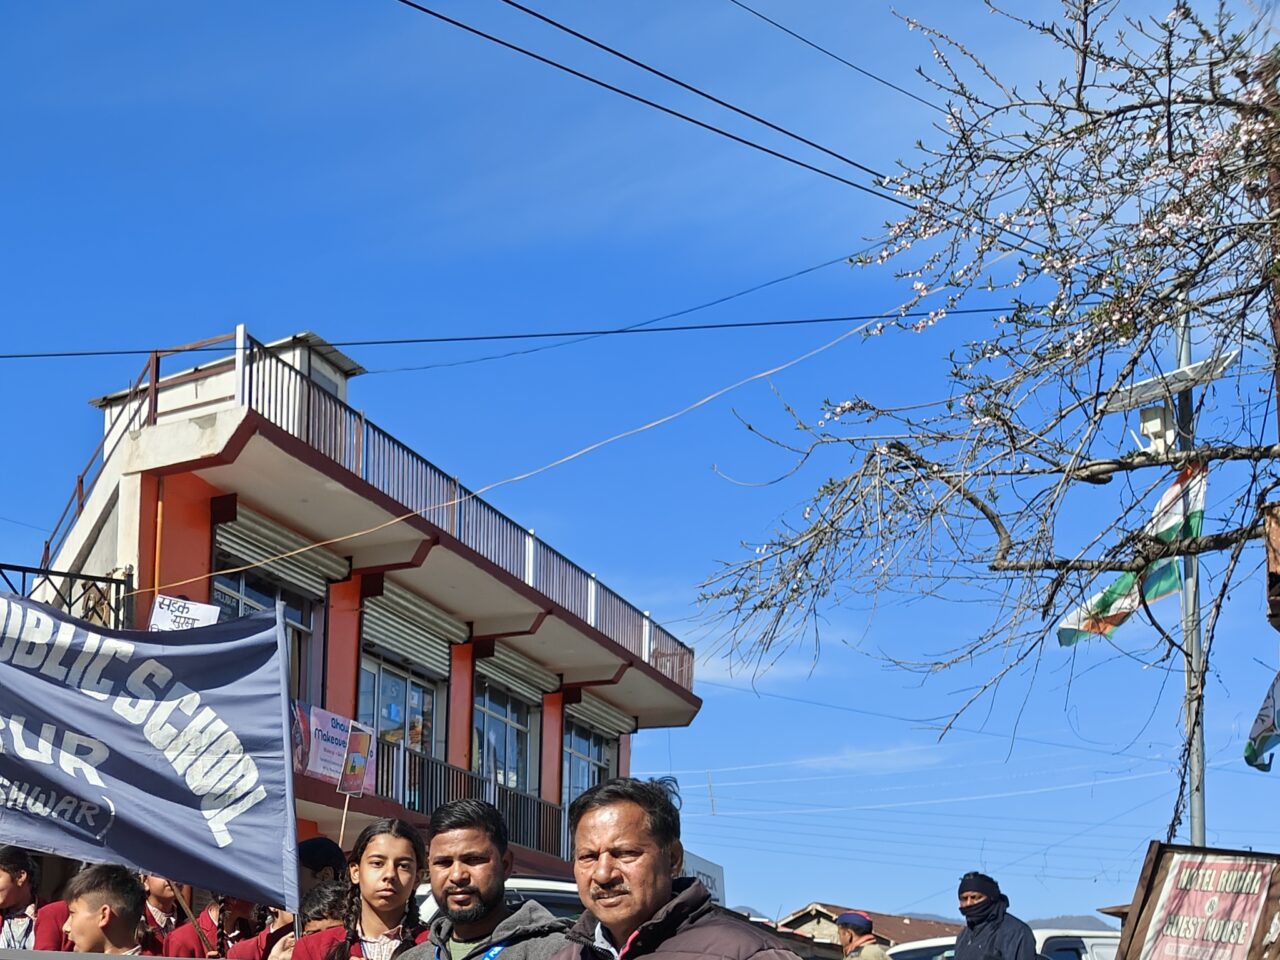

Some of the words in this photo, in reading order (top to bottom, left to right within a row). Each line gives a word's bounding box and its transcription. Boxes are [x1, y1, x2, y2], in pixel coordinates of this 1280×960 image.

[112, 658, 268, 849] SCHOOL
[1177, 868, 1217, 893] HOTEL
[1162, 915, 1205, 941] GUEST
[1203, 918, 1249, 945] HOUSE
